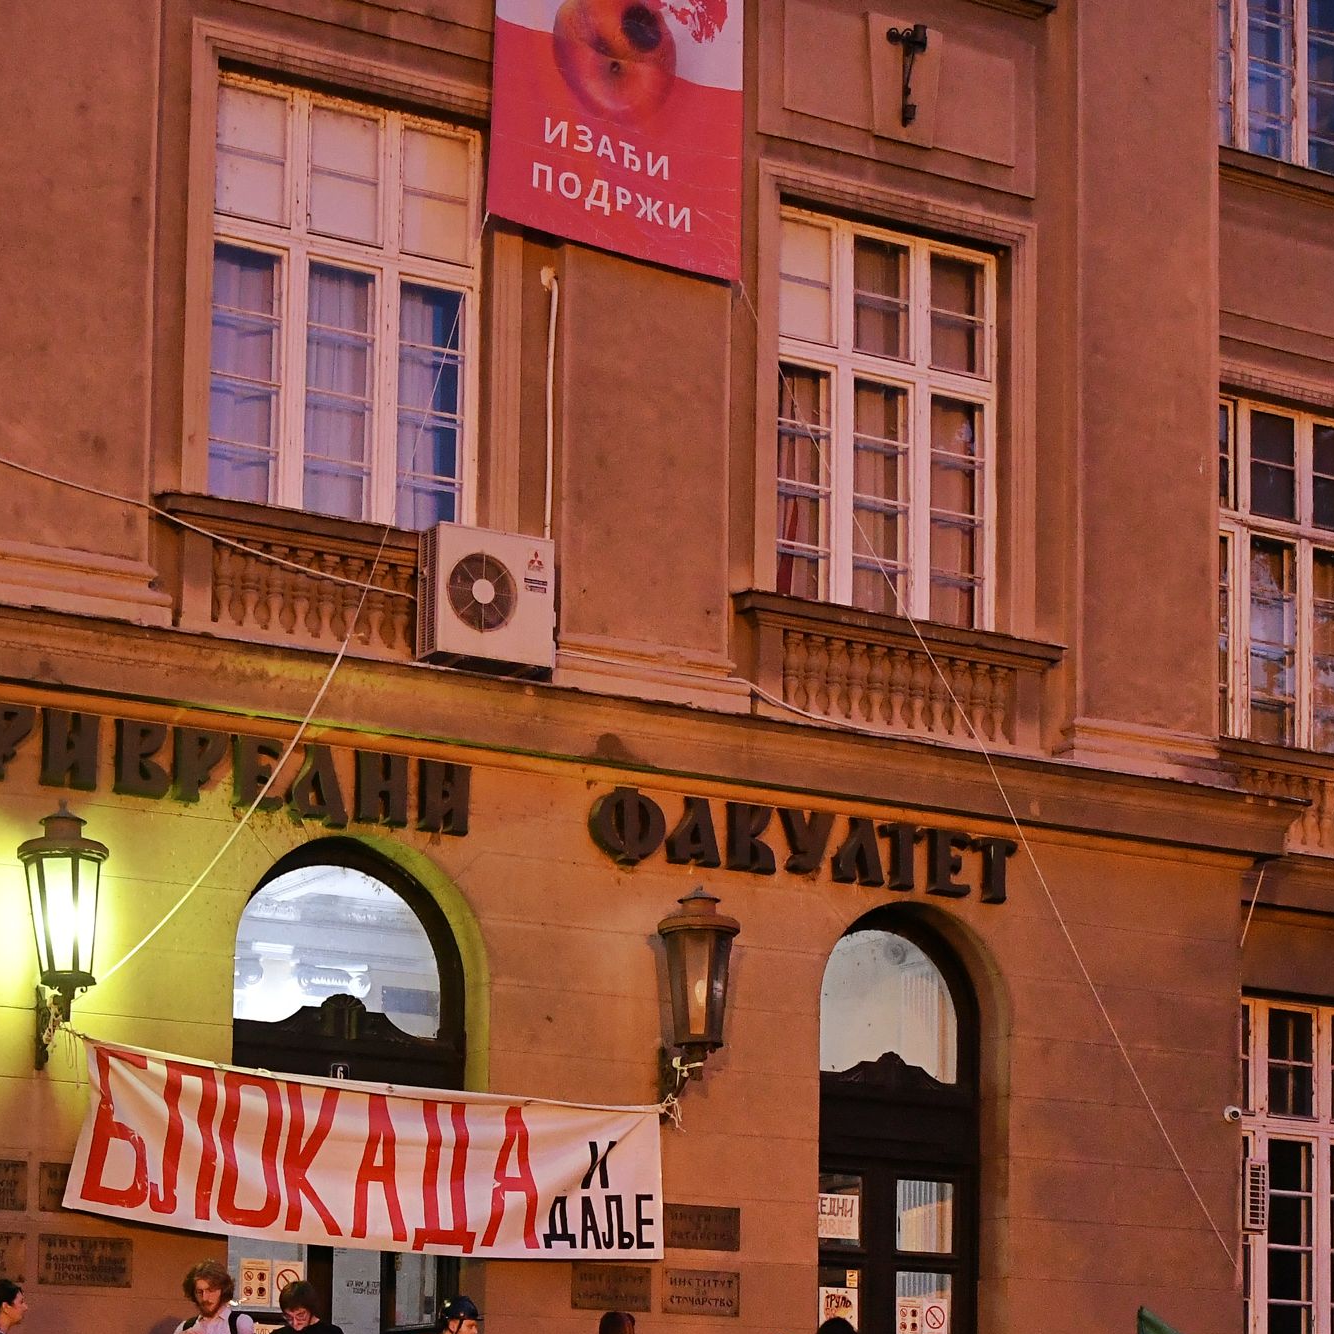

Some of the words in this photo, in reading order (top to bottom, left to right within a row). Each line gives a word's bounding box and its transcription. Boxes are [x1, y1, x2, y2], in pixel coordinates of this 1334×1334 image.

[543, 116, 670, 181] ИЗАЂИ
[531, 160, 692, 234] ПОДРЖИ
[588, 786, 1017, 904] ФАКУЛТЕТ
[80, 1046, 541, 1254] БЛОКАДА
[581, 1140, 618, 1190] И
[543, 1193, 655, 1250] ДАЉЕ
[670, 1277, 734, 1289] ИНСТИТУТ
